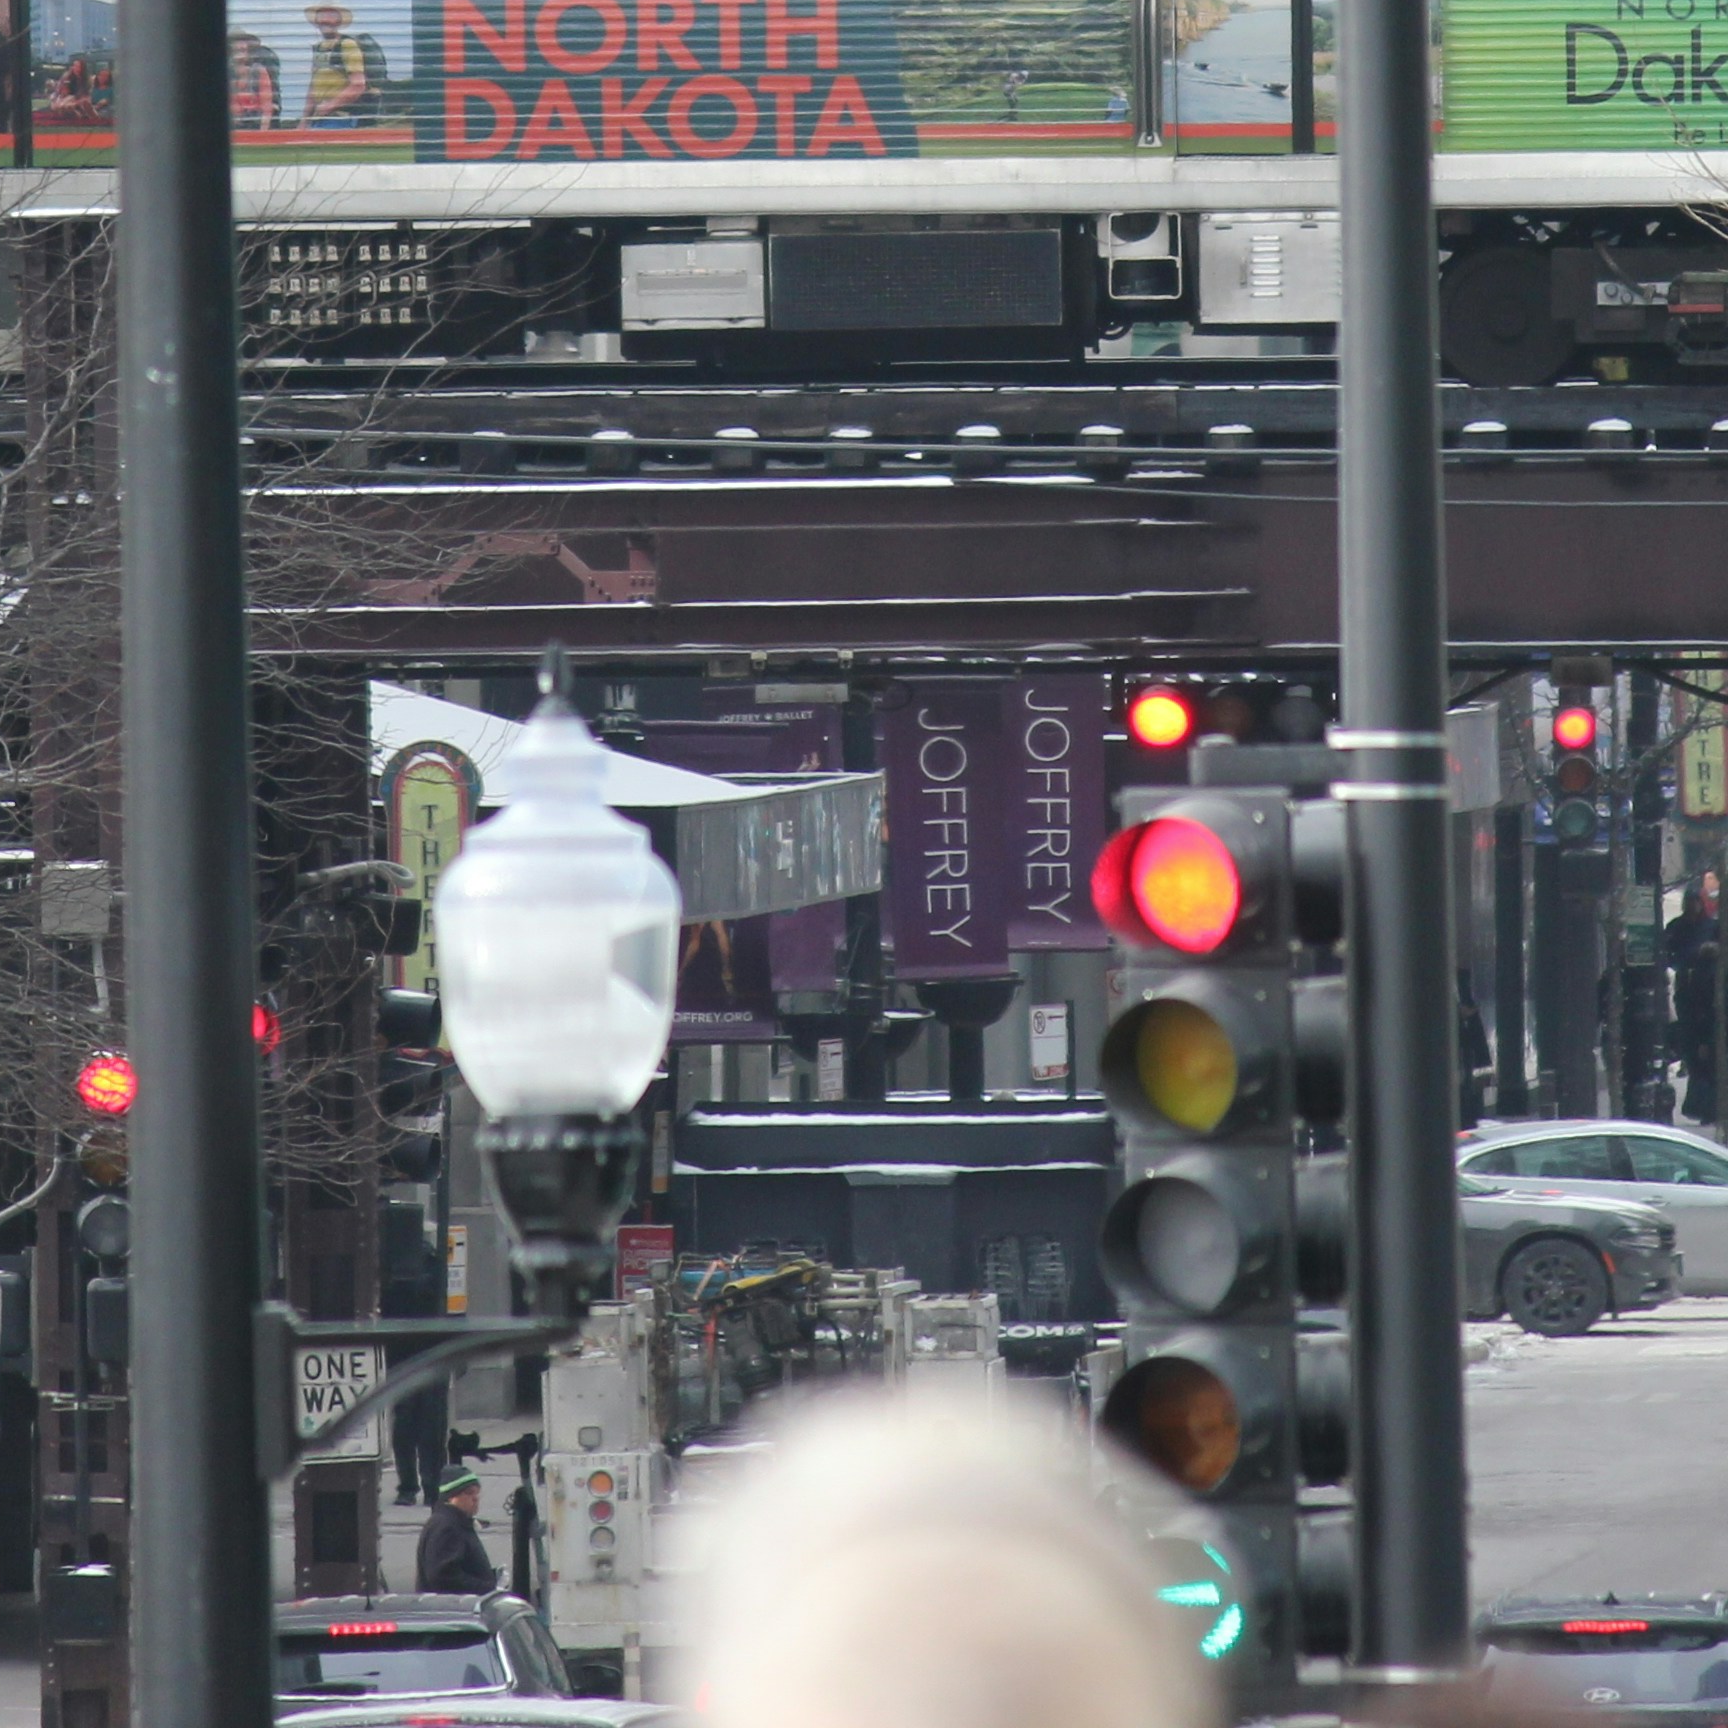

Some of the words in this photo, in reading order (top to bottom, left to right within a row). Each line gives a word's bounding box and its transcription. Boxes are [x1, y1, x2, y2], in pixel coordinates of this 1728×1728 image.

[443, 74, 887, 160] DAKOTA
[918, 708, 972, 947] JOFFREY
[1025, 689, 1071, 923] JOFFREY
[673, 1010, 753, 1023] OFFREY.ORG
[304, 1352, 367, 1380] ONE
[303, 1385, 369, 1414] WAY
